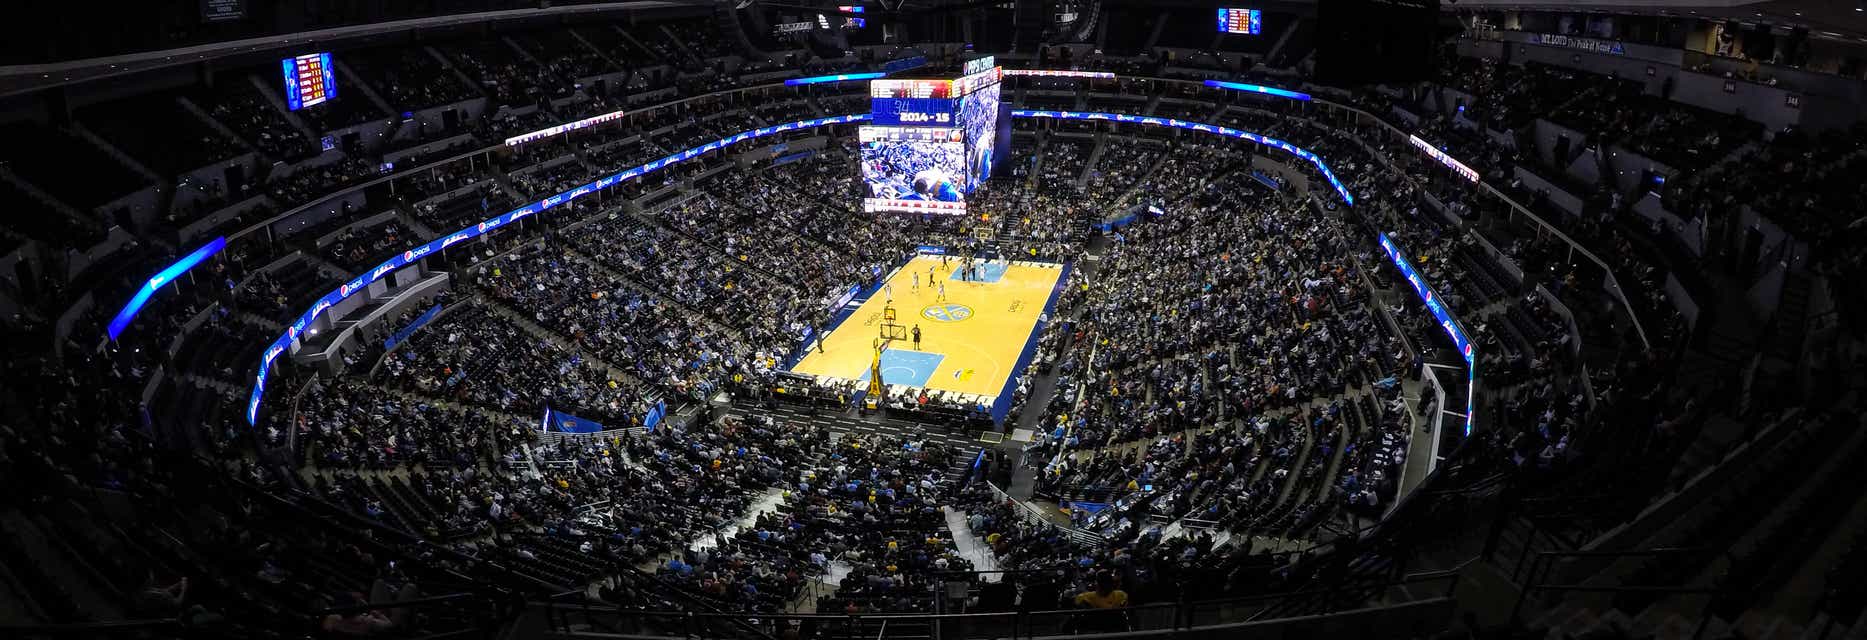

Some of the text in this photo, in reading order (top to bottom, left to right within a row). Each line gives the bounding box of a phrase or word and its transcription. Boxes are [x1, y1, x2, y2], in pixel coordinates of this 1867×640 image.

[900, 112, 928, 122] 2014
[936, 113, 949, 122] 15
[413, 245, 430, 258] pepsi
[348, 278, 363, 292] pepsi
